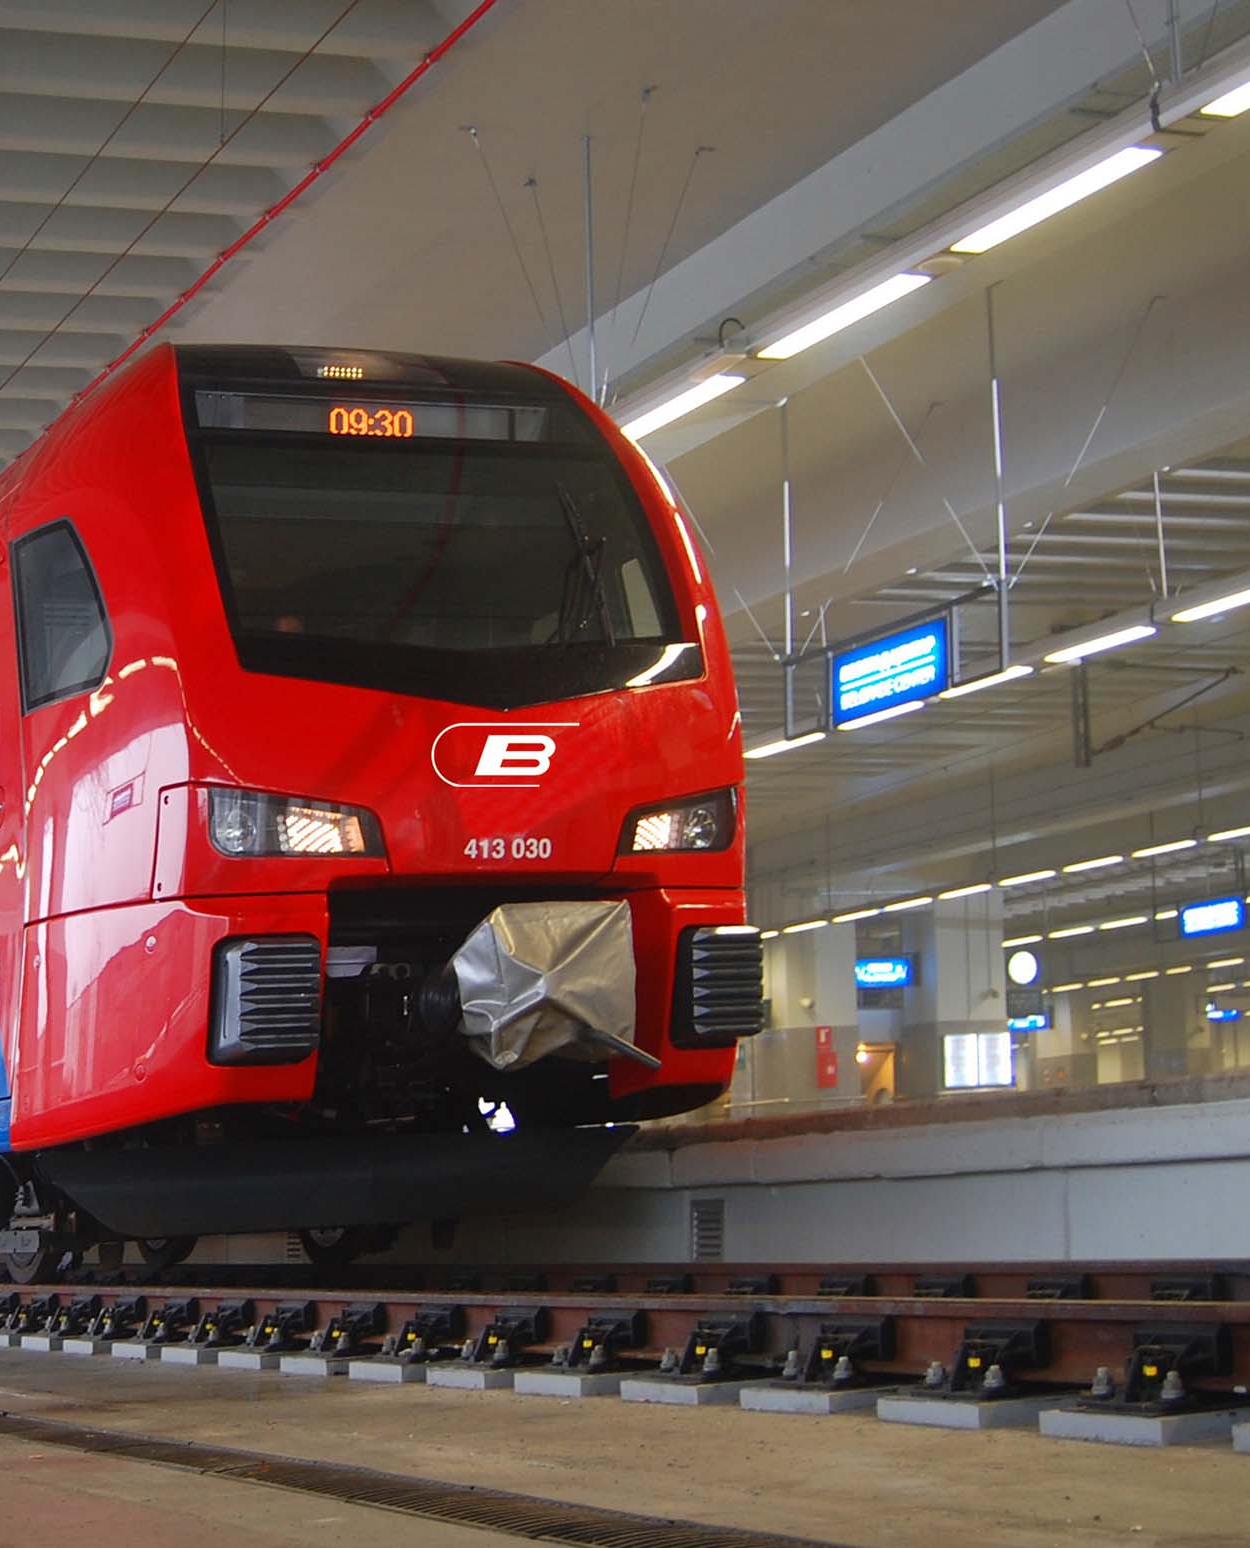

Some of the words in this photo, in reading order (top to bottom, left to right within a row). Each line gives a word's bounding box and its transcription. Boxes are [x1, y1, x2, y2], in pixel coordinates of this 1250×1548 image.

[328, 406, 414, 438] 09:30
[463, 838, 505, 860] 413
[511, 838, 552, 860] 030
